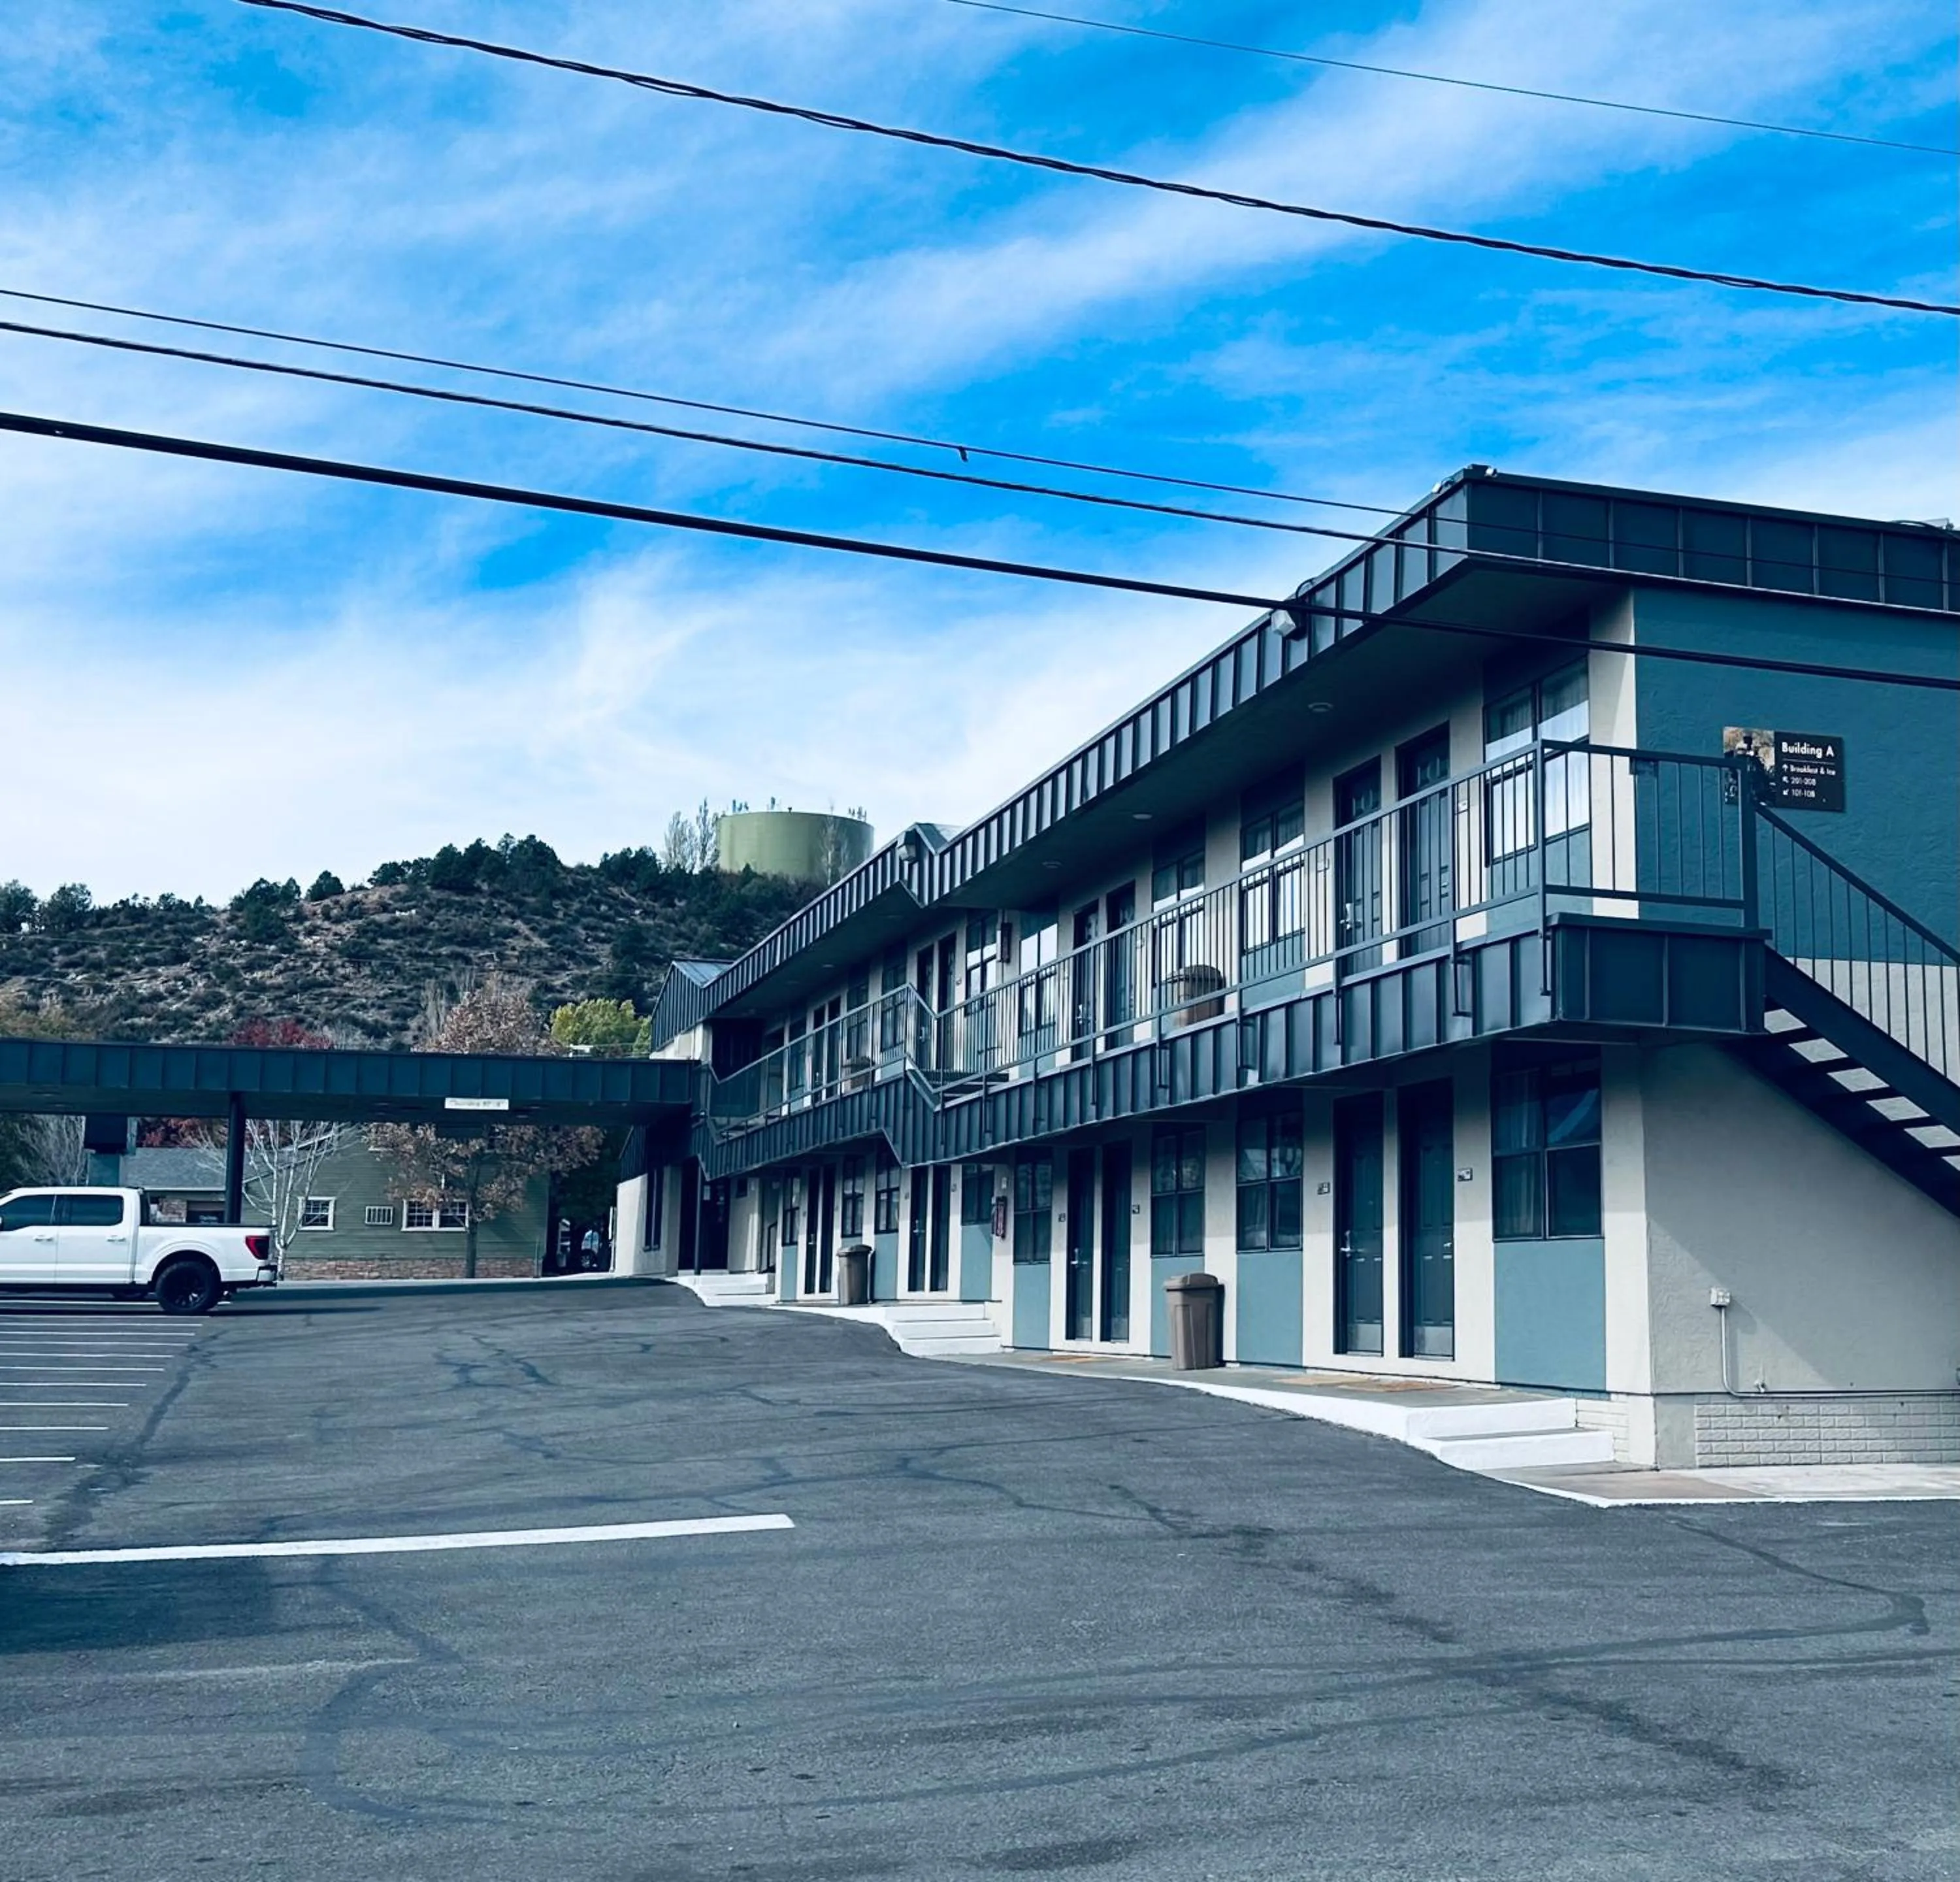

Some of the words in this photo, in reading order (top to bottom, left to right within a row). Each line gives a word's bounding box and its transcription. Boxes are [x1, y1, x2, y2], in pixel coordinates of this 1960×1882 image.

[1782, 742, 1822, 759] Building
[1826, 745, 1835, 757] A
[1790, 764, 1818, 774] Breakfast
[1820, 766, 1825, 774] &
